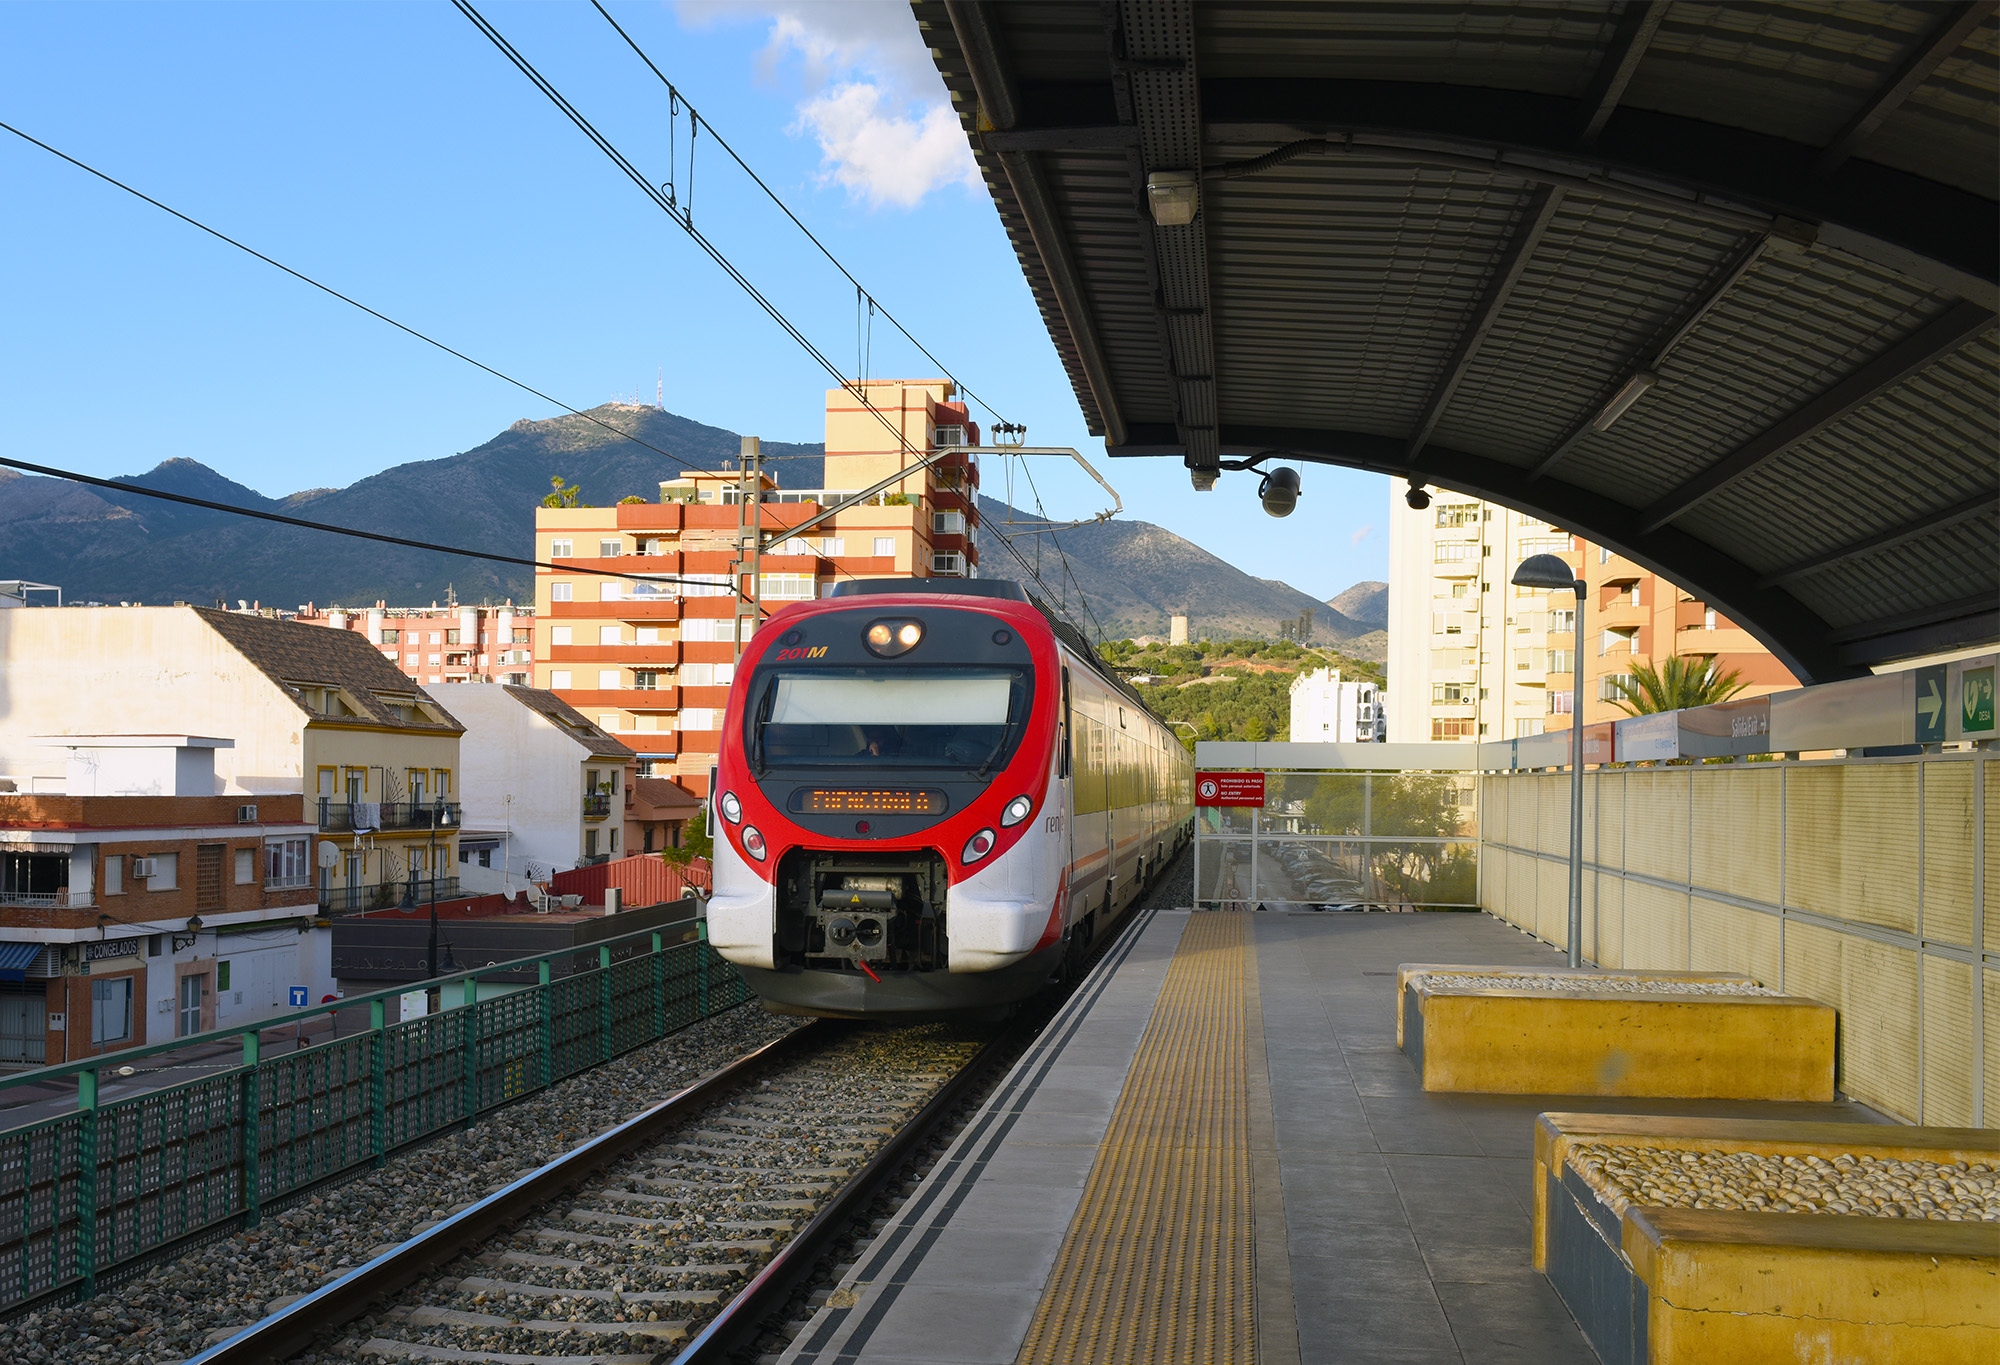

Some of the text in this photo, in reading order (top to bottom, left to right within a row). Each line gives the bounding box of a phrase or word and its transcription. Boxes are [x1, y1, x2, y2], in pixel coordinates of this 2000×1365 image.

[776, 646, 828, 661] 201M
[1979, 710, 1990, 721] DESA
[94, 940, 137, 959] CONGELADOS
